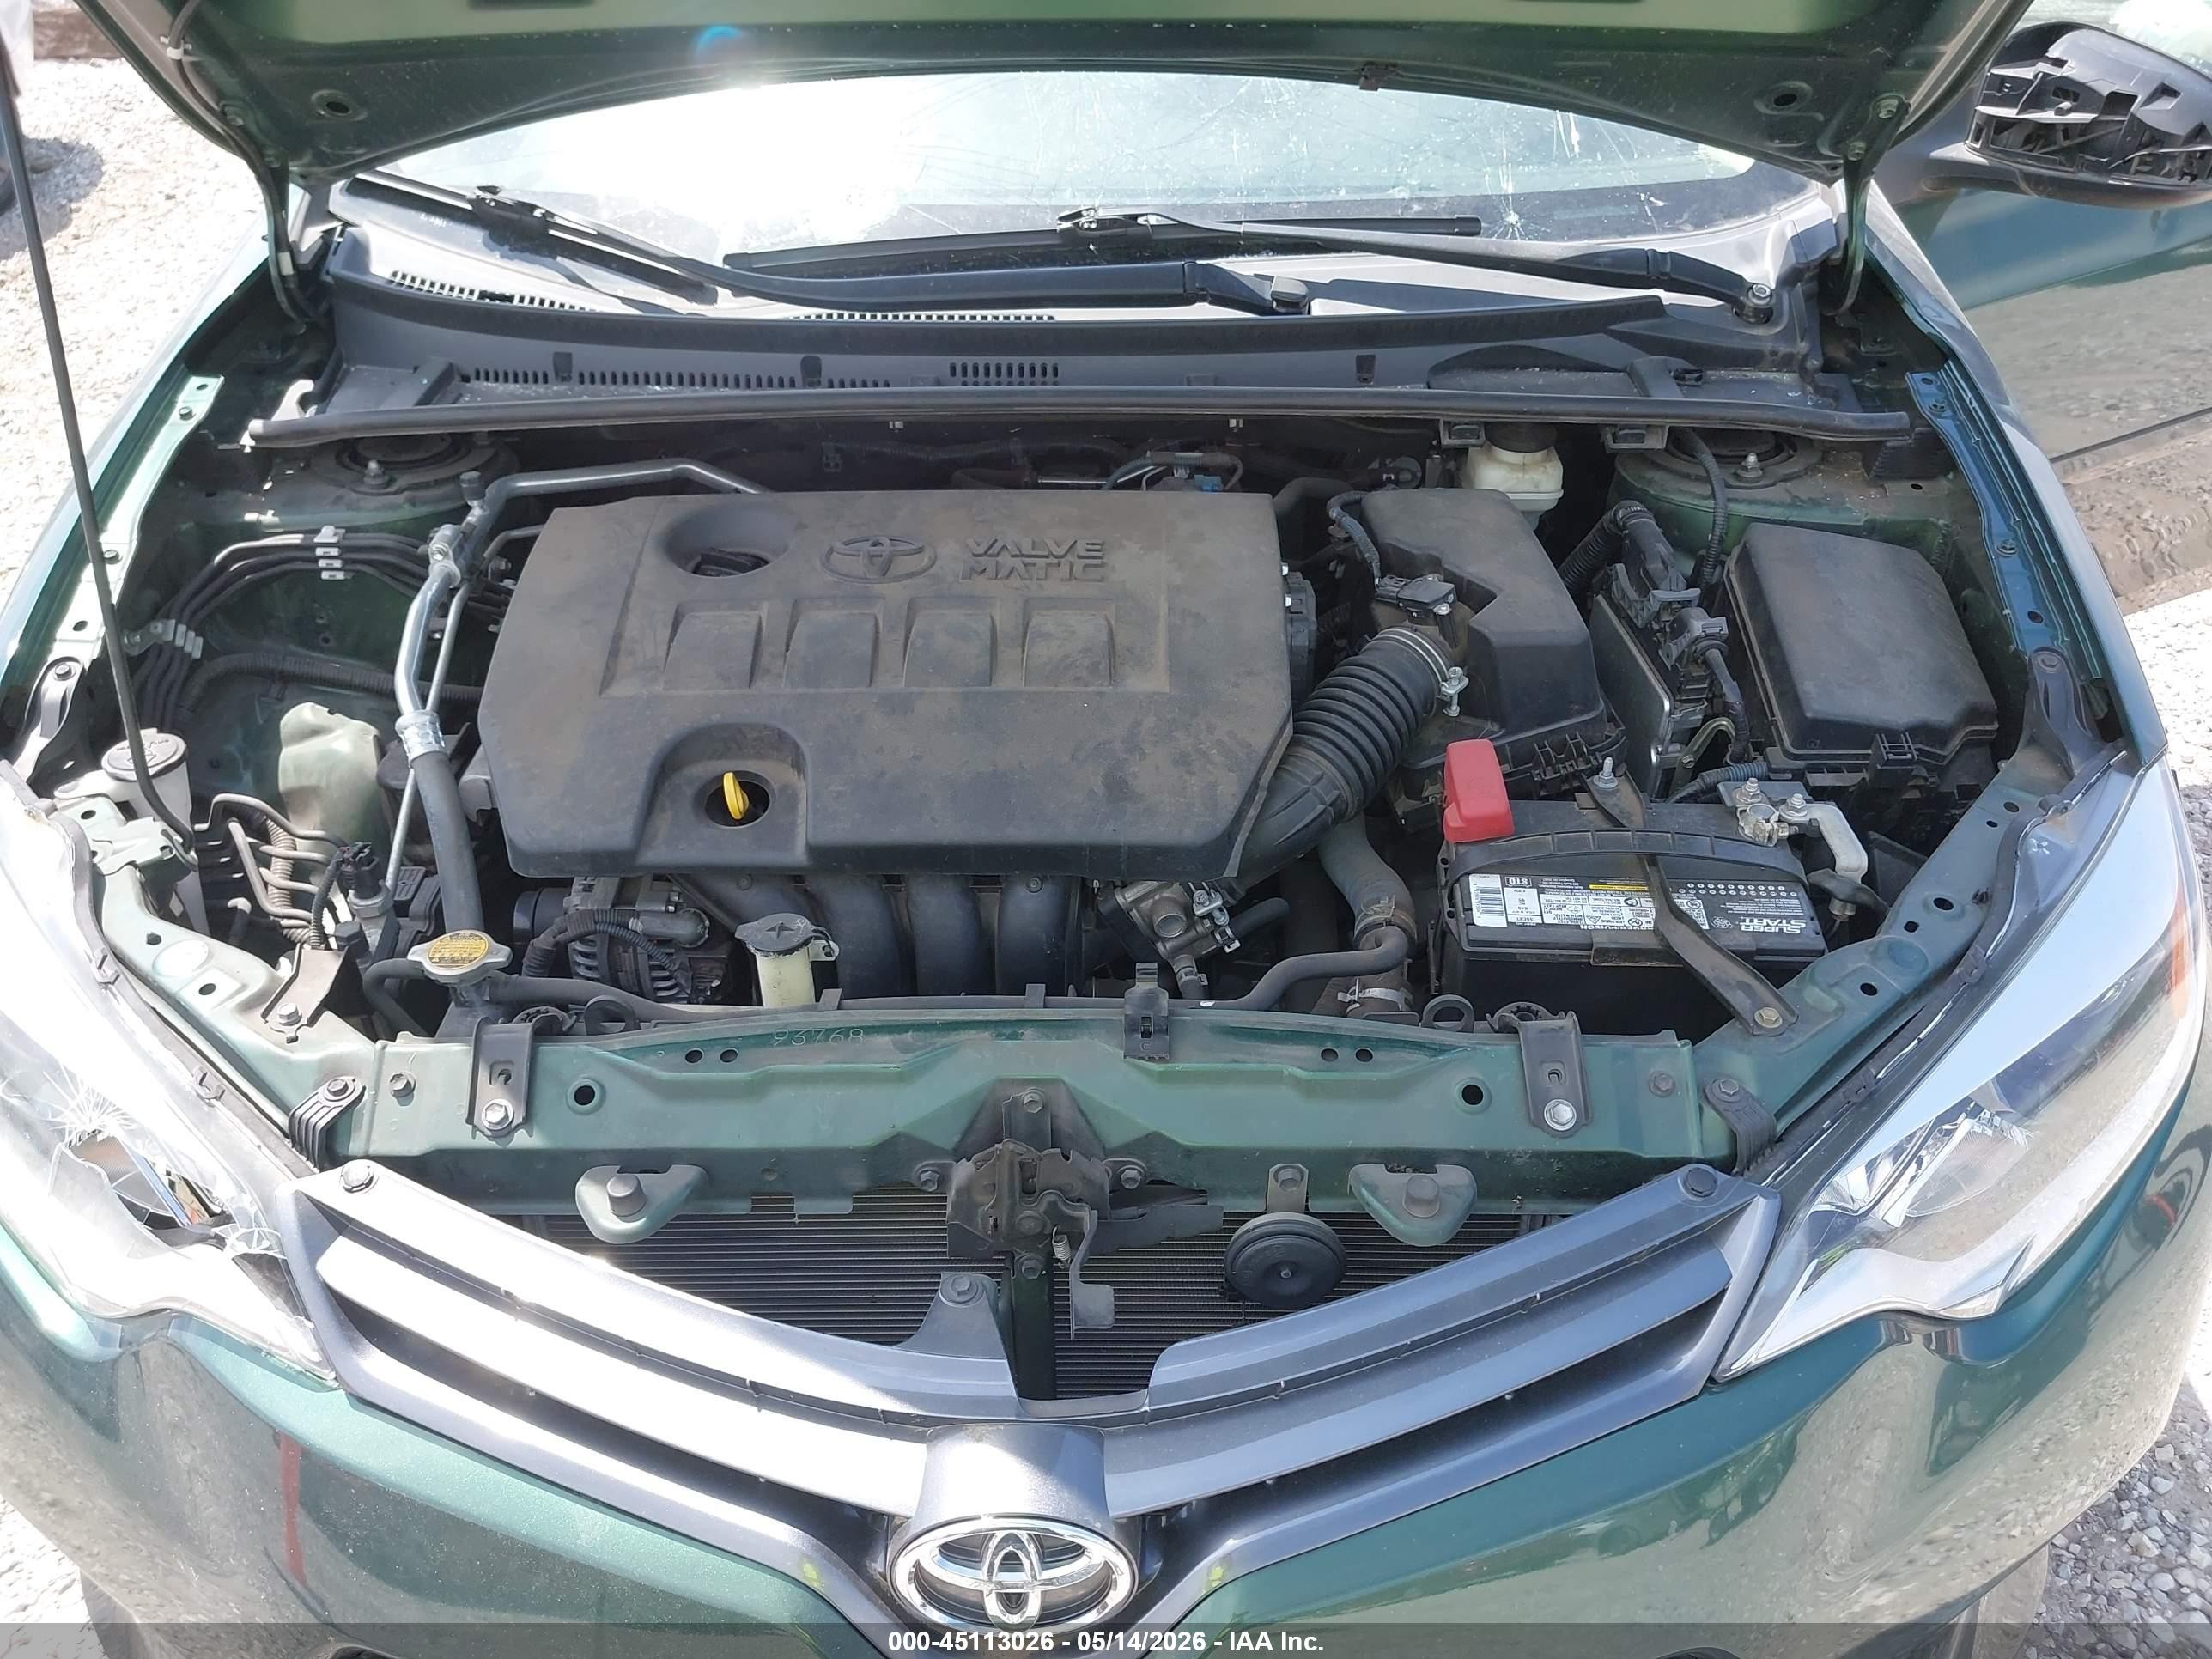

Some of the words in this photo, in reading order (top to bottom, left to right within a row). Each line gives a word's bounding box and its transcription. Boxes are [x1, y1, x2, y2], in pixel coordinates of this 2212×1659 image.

[966, 538, 1105, 558] VALVE
[959, 558, 1105, 581] MATIC
[1739, 918, 1807, 928] START
[1741, 925, 1802, 934] SUPER
[773, 1029, 865, 1046] 93768
